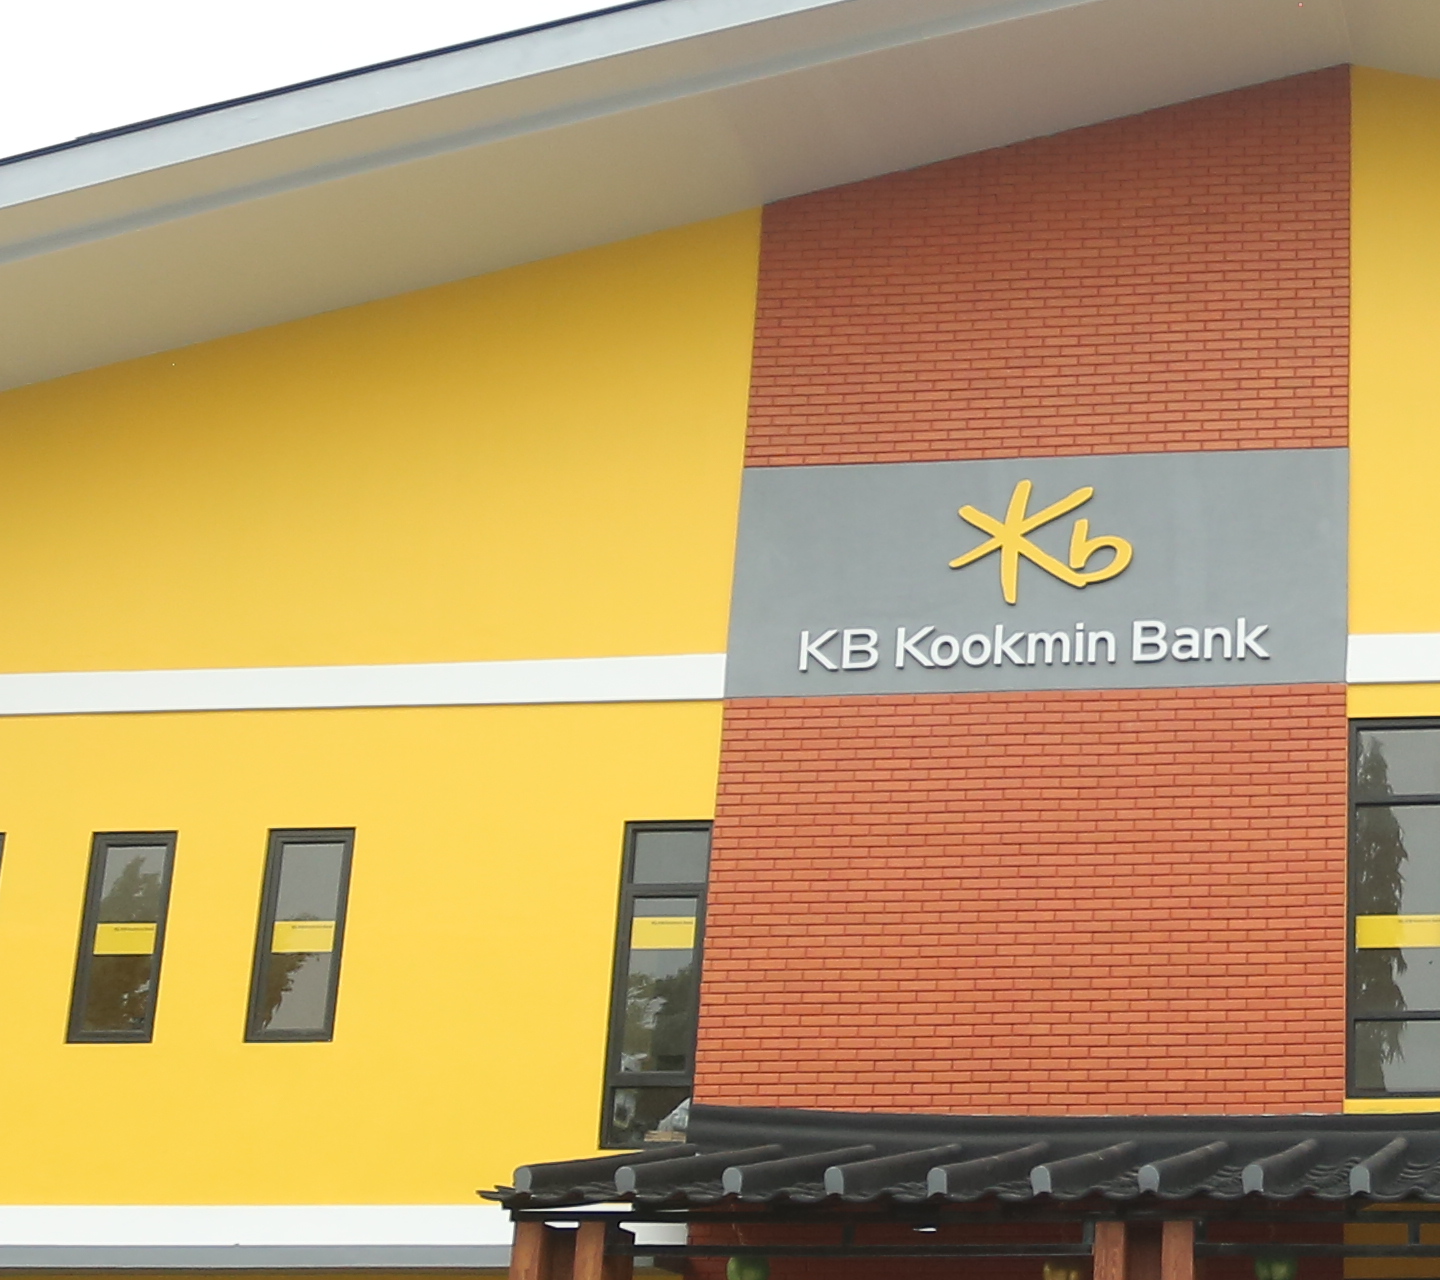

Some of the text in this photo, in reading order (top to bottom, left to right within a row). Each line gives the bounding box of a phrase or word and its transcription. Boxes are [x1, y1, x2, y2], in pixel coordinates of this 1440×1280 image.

[798, 617, 1272, 672] KB Kookmin Bank
